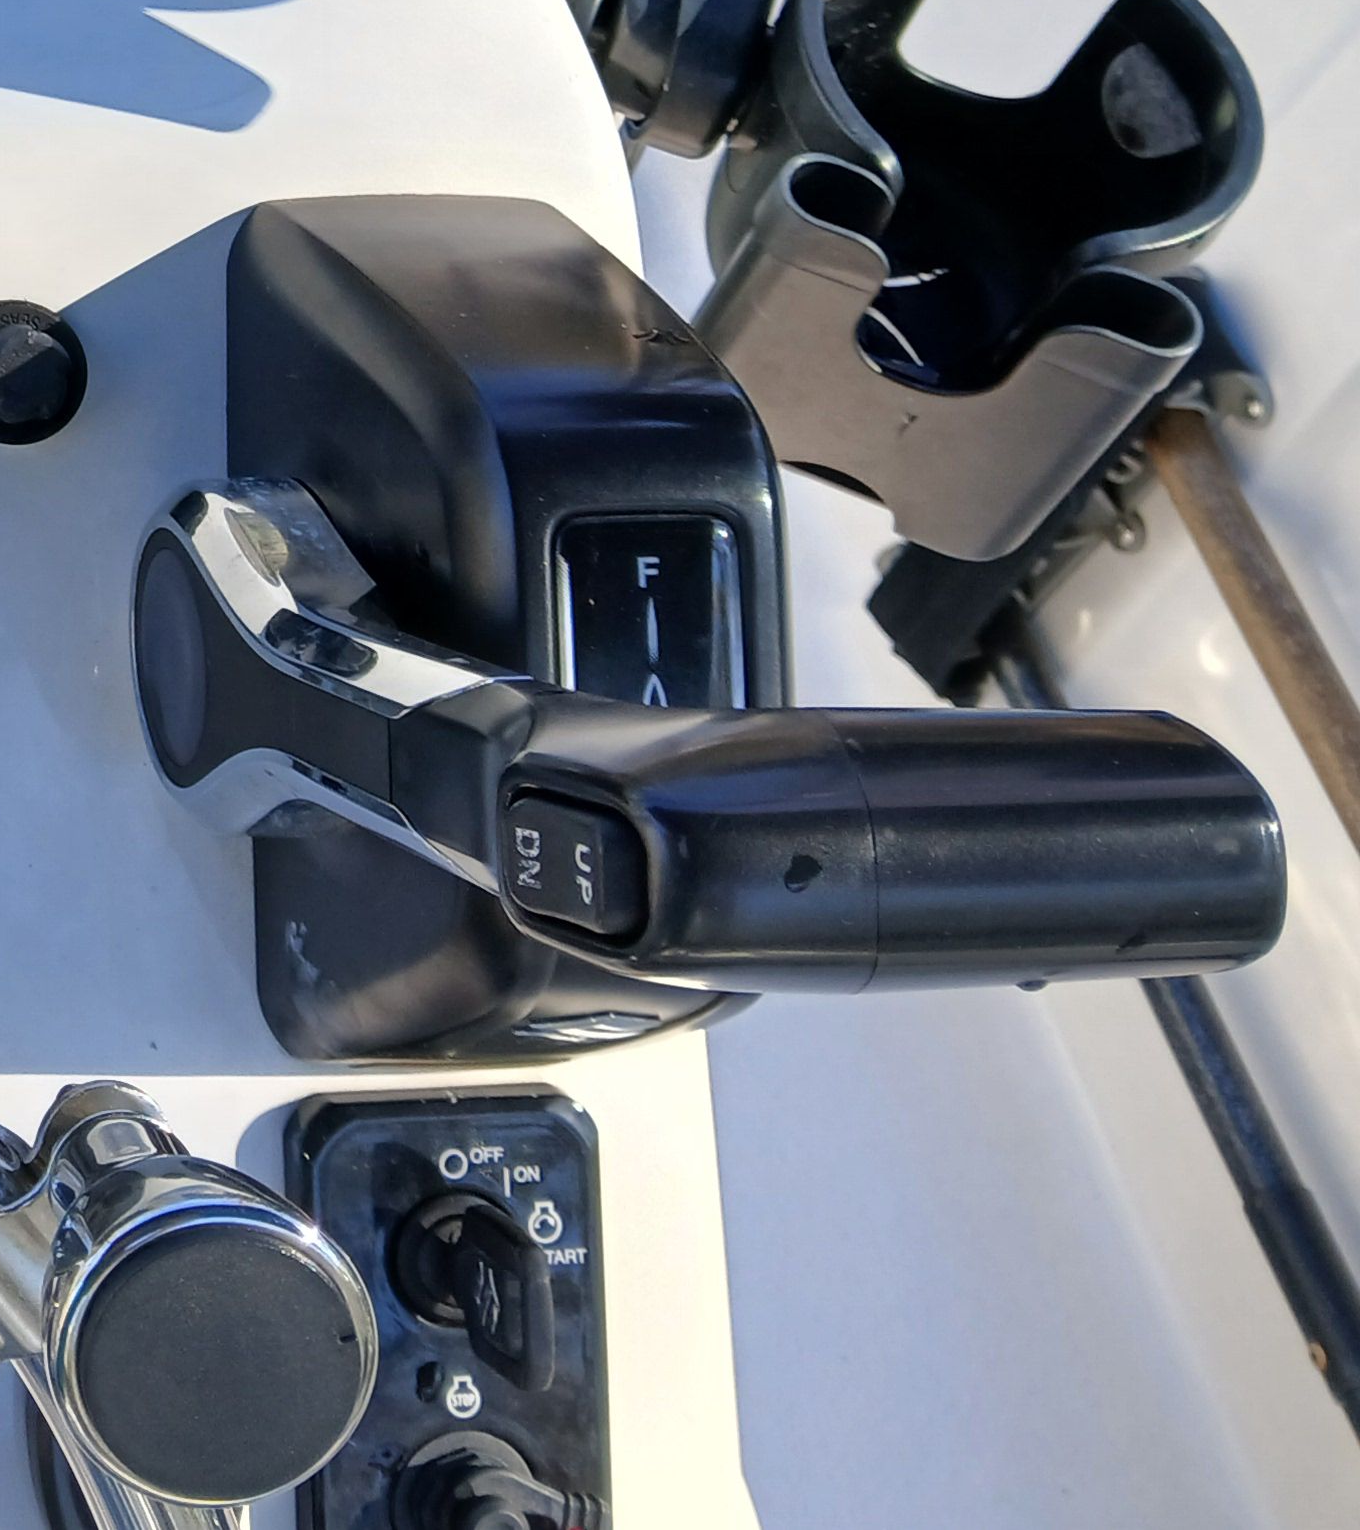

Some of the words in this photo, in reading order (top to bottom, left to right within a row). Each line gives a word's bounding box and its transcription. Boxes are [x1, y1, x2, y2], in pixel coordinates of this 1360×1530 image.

[637, 556, 661, 589] F
[515, 827, 542, 889] DN
[575, 843, 593, 905] UP
[469, 1147, 504, 1164] OFF
[513, 1166, 541, 1183] ON
[546, 1248, 587, 1264] TART
[450, 1392, 476, 1408] STOP
